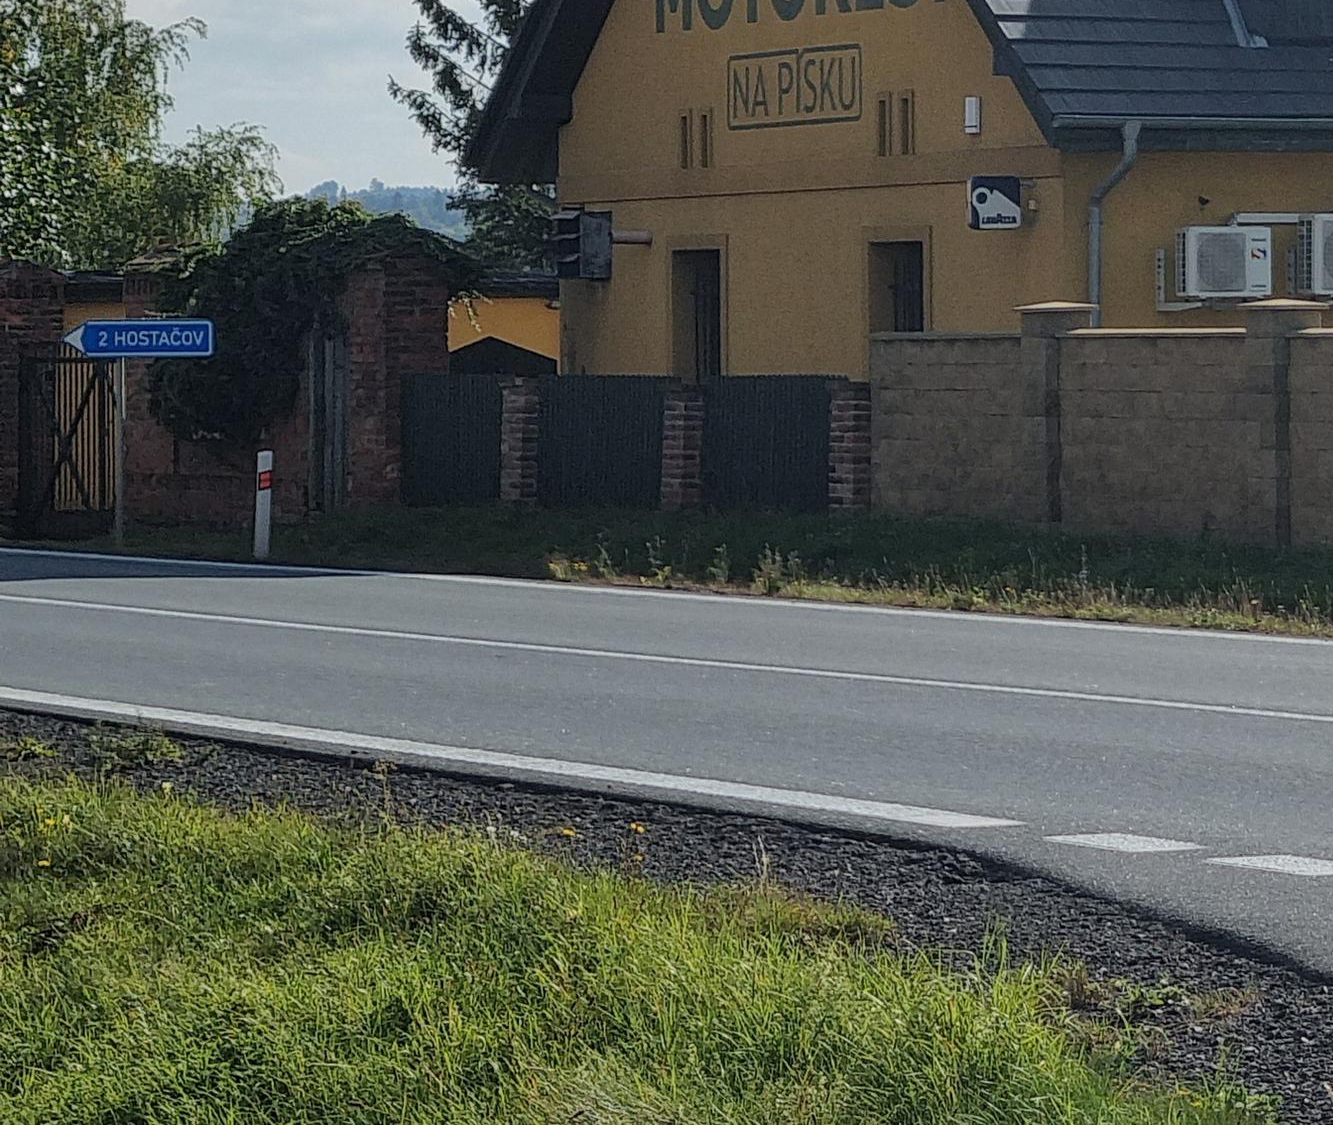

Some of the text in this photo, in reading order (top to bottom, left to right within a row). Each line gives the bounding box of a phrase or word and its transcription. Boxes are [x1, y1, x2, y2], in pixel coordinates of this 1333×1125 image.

[732, 65, 769, 118] NA
[98, 327, 204, 347] 2 HOSTAČOV
